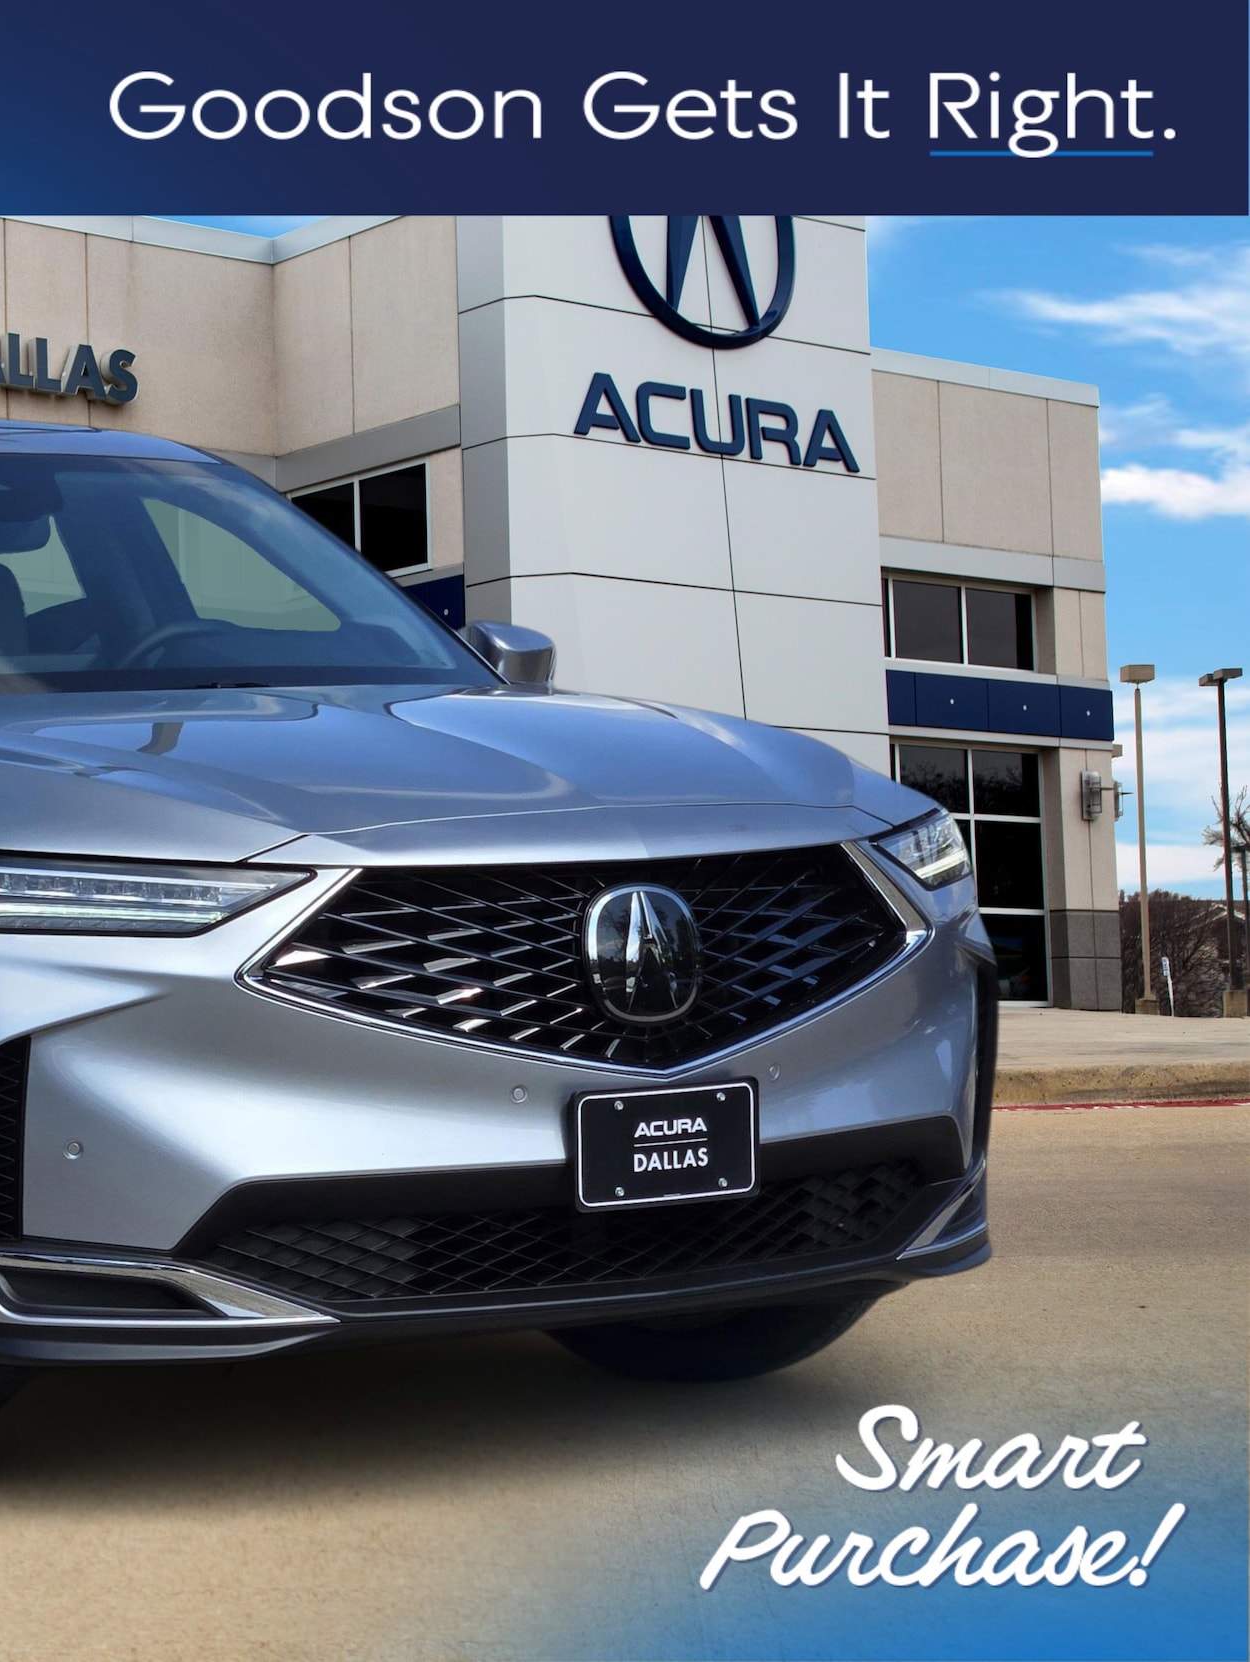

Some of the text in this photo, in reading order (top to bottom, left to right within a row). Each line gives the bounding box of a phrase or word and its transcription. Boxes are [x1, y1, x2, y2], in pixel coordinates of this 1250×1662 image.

[574, 372, 860, 473] ACURA
[633, 1117, 708, 1138] ACURA
[633, 1147, 709, 1173] DALLAS
